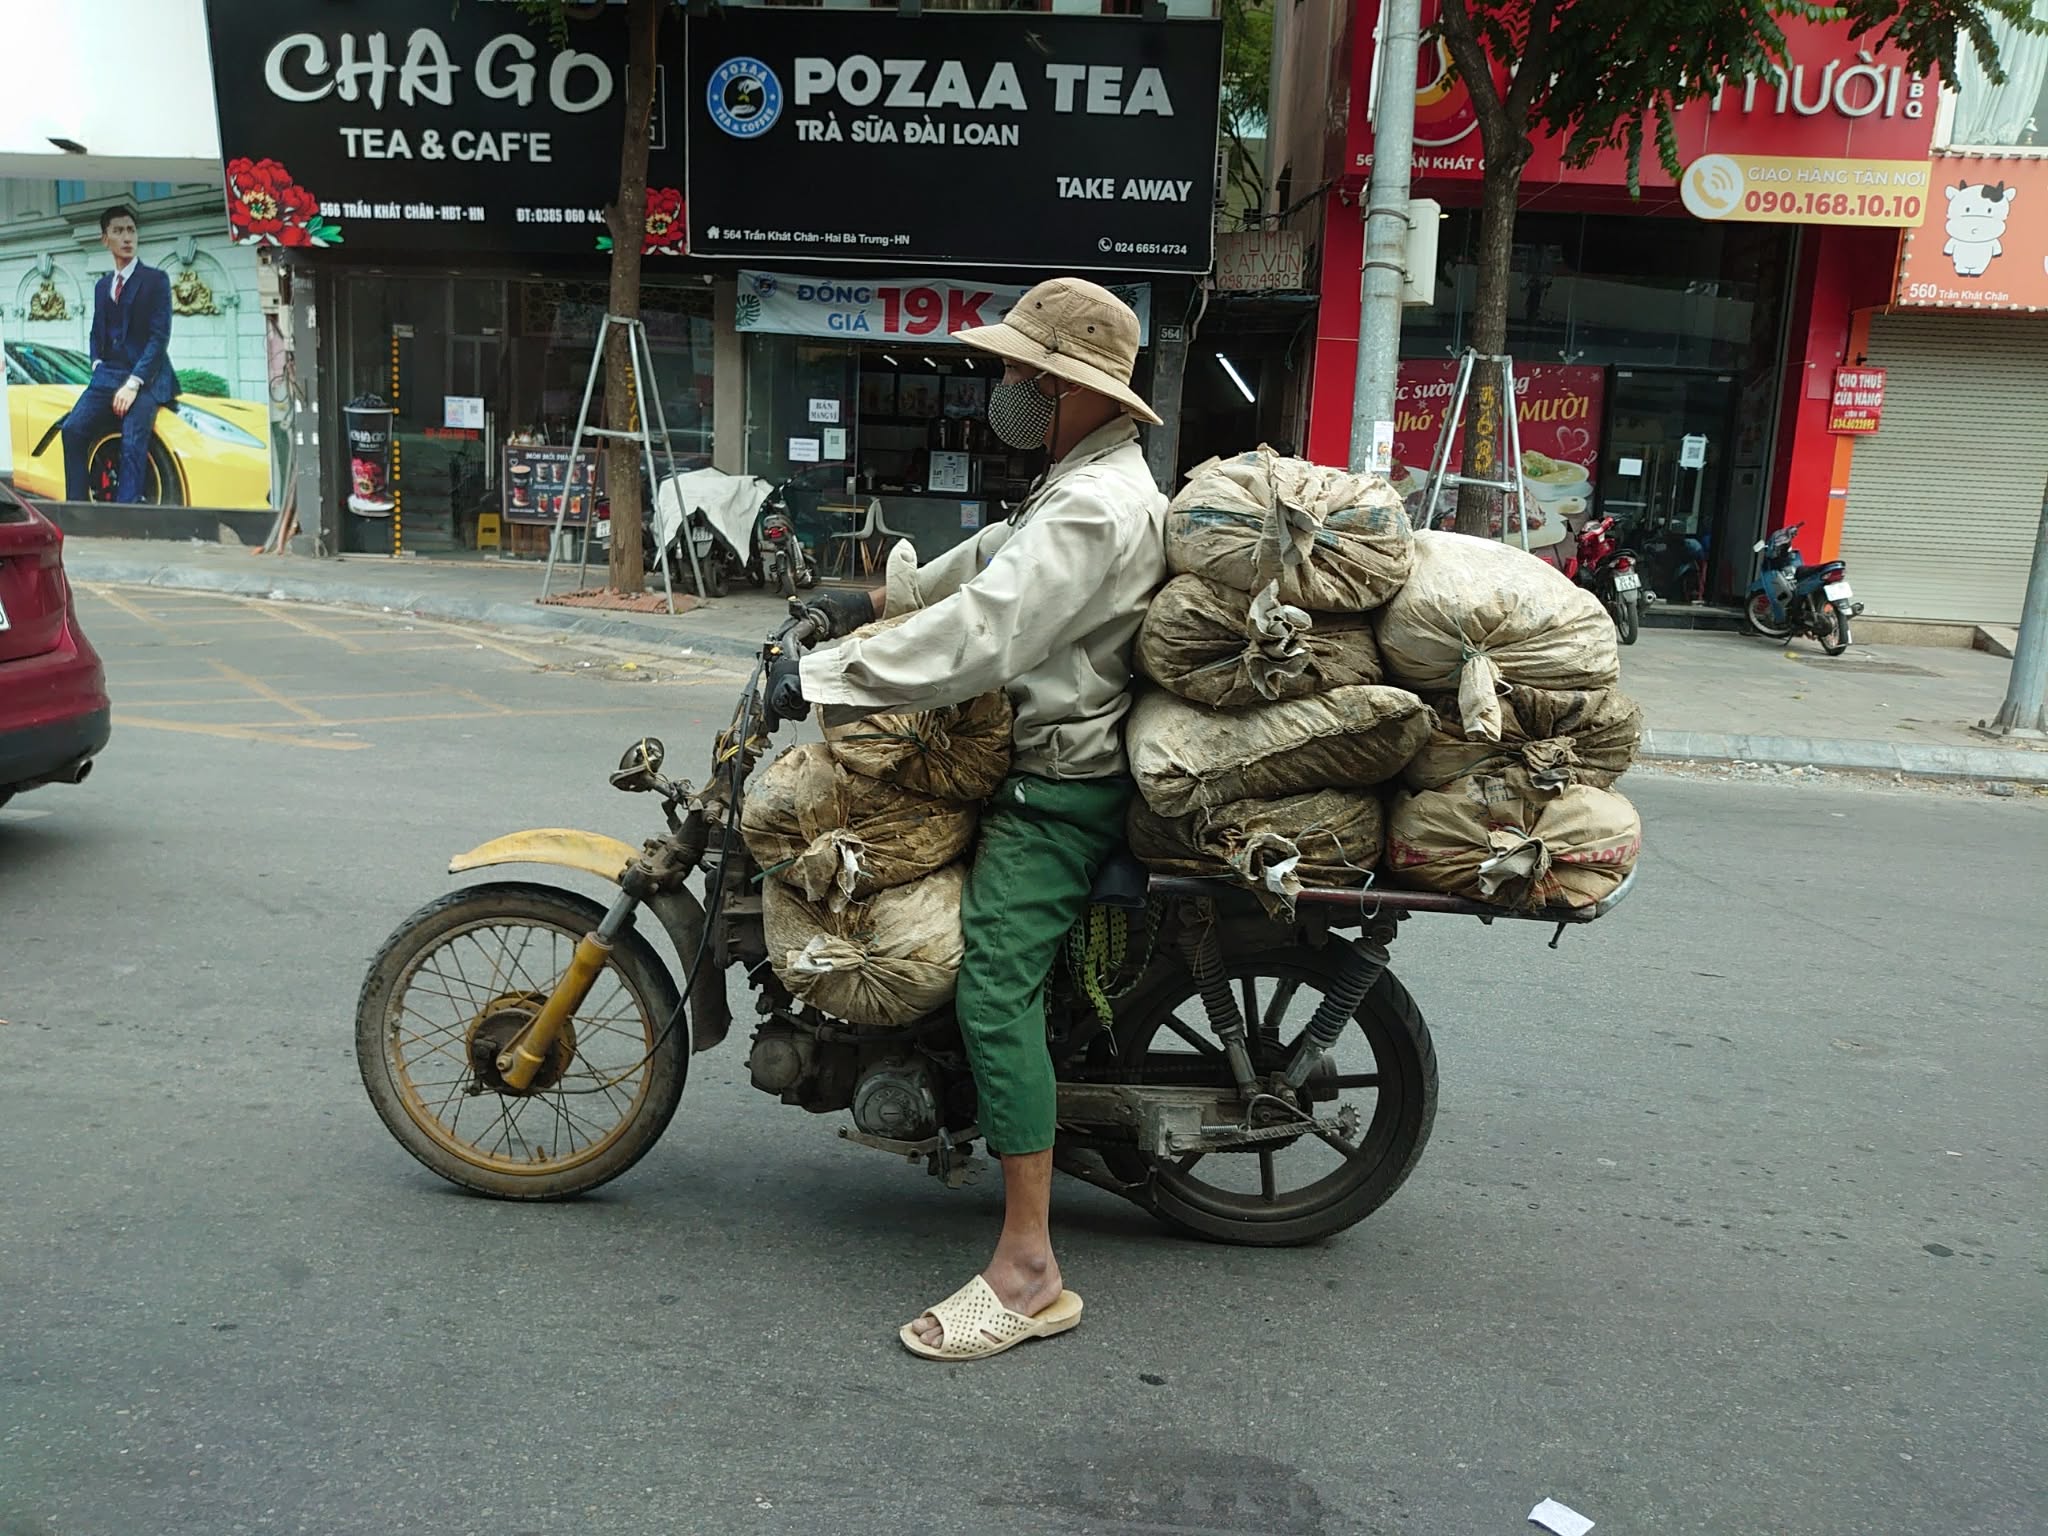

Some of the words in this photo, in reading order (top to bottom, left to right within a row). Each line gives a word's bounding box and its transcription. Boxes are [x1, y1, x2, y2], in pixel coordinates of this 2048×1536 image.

[720, 62, 767, 82] POZAA
[794, 55, 1028, 111] POZAA
[1045, 63, 1174, 117] TEA
[796, 111, 843, 142] TRÀ
[851, 115, 898, 143] SỮA
[903, 114, 945, 144] ĐÀI
[953, 123, 1019, 146] LOAN
[340, 127, 413, 159] TEA
[420, 130, 446, 160] &
[1432, 155, 1475, 170] KHÁT
[1747, 167, 1793, 182] GIAO
[1056, 177, 1115, 199] TAKE
[1121, 179, 1193, 202] AWAY
[320, 202, 341, 217] 566
[1744, 190, 1921, 218] 090.168.10.10
[723, 230, 742, 240] 564
[1115, 242, 1134, 253] 024
[1136, 243, 1187, 255] 66514734
[796, 280, 871, 304] ĐỒNG
[1909, 283, 1937, 299] 560
[827, 310, 870, 332] GIÁ
[877, 287, 994, 336] 19K
[1160, 327, 1180, 339] 564
[1839, 373, 1857, 388] CHO
